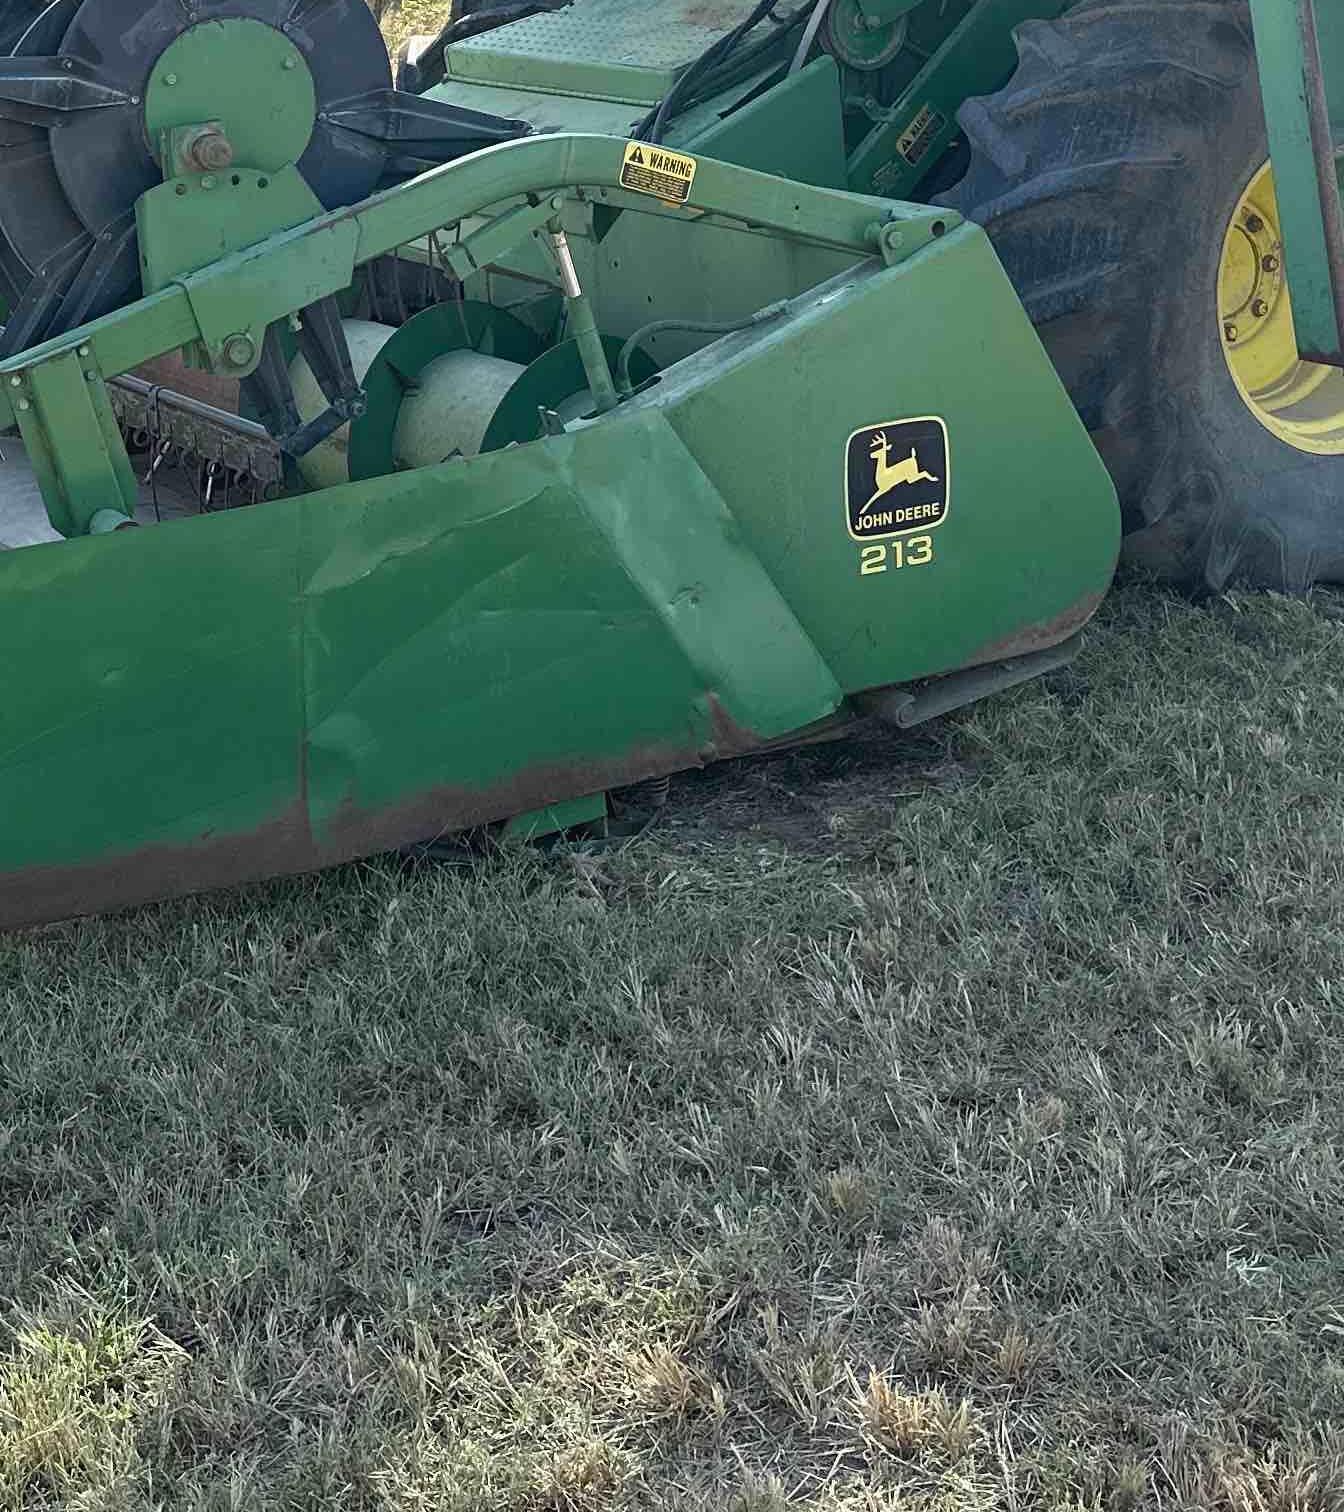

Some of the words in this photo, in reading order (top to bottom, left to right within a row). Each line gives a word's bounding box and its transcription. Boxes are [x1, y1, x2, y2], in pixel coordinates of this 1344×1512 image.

[649, 151, 693, 178] WARNING
[855, 510, 893, 531] JOHN
[895, 502, 940, 522] DEERE
[861, 535, 933, 575] 213
